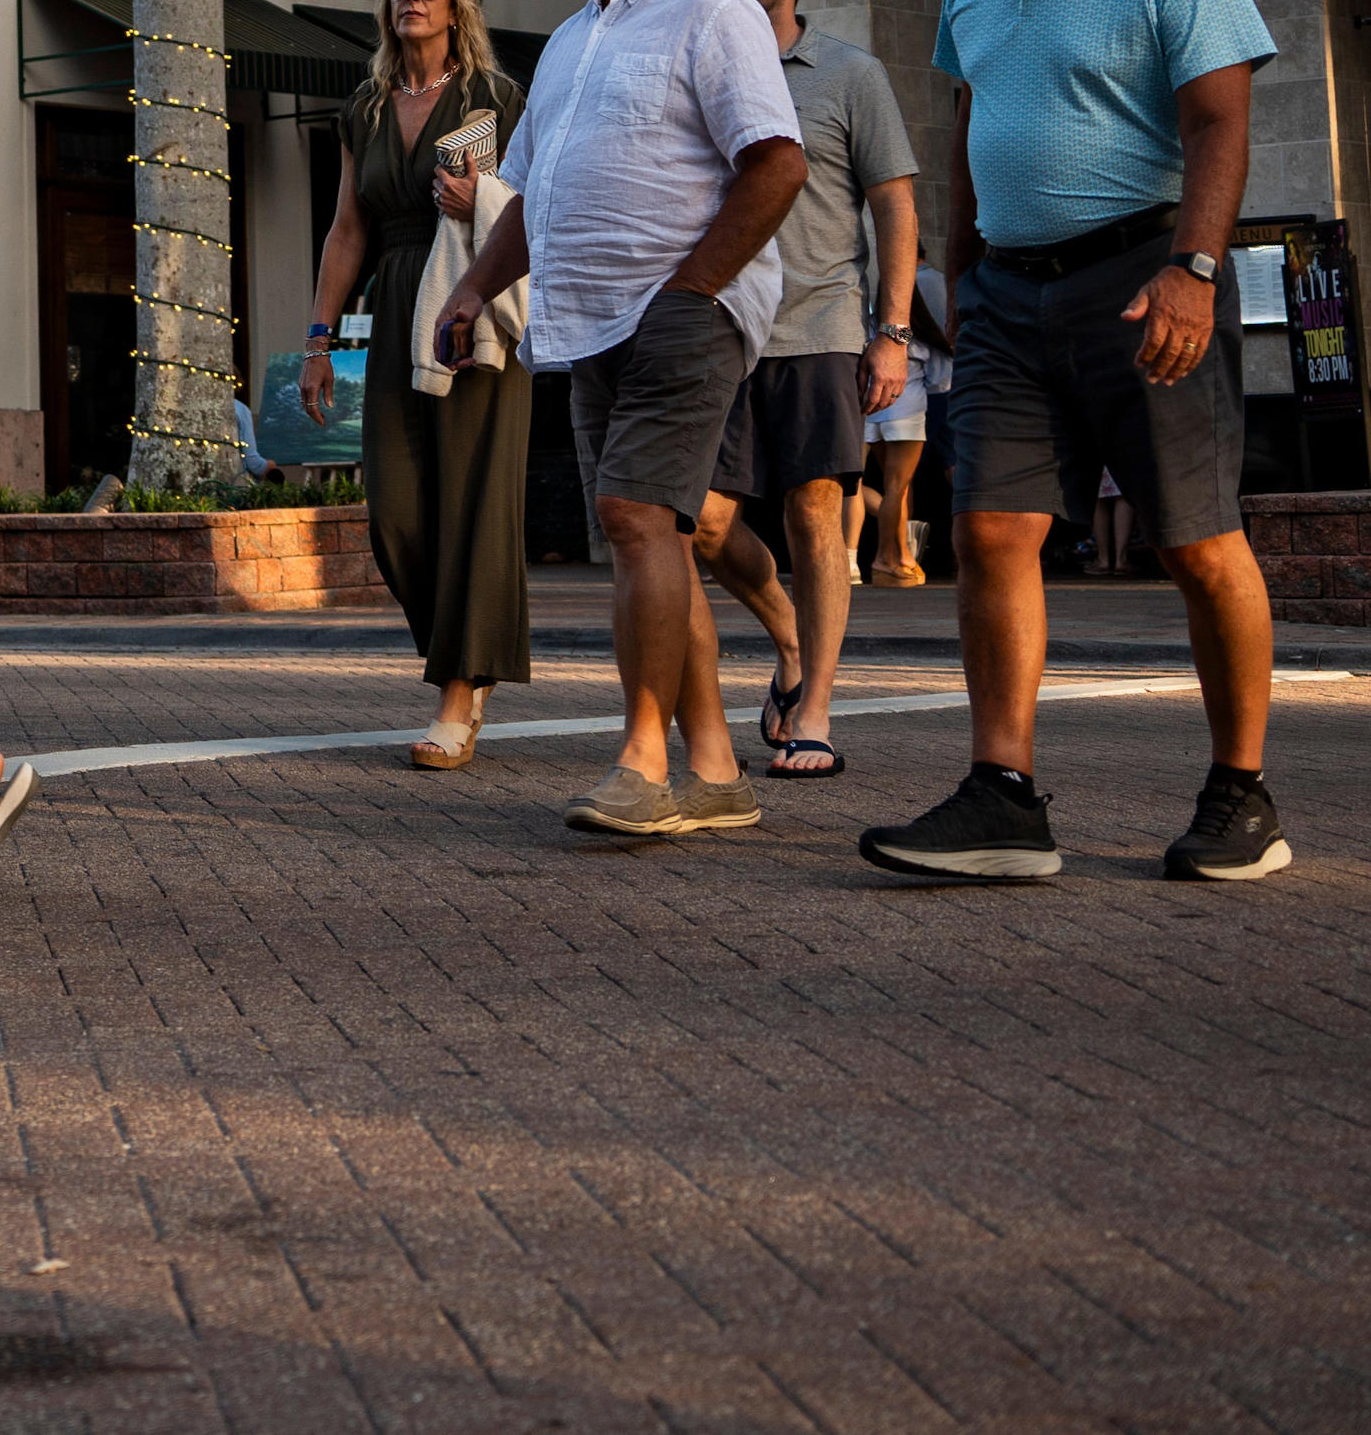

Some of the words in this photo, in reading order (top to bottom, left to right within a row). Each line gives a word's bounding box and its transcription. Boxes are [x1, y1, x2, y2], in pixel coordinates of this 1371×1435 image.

[1297, 268, 1342, 302] LIVE
[1300, 298, 1345, 330] MUSIC
[1303, 326, 1346, 358] TONIGHT
[1308, 356, 1331, 383] 8:30
[1332, 355, 1349, 382] PM
